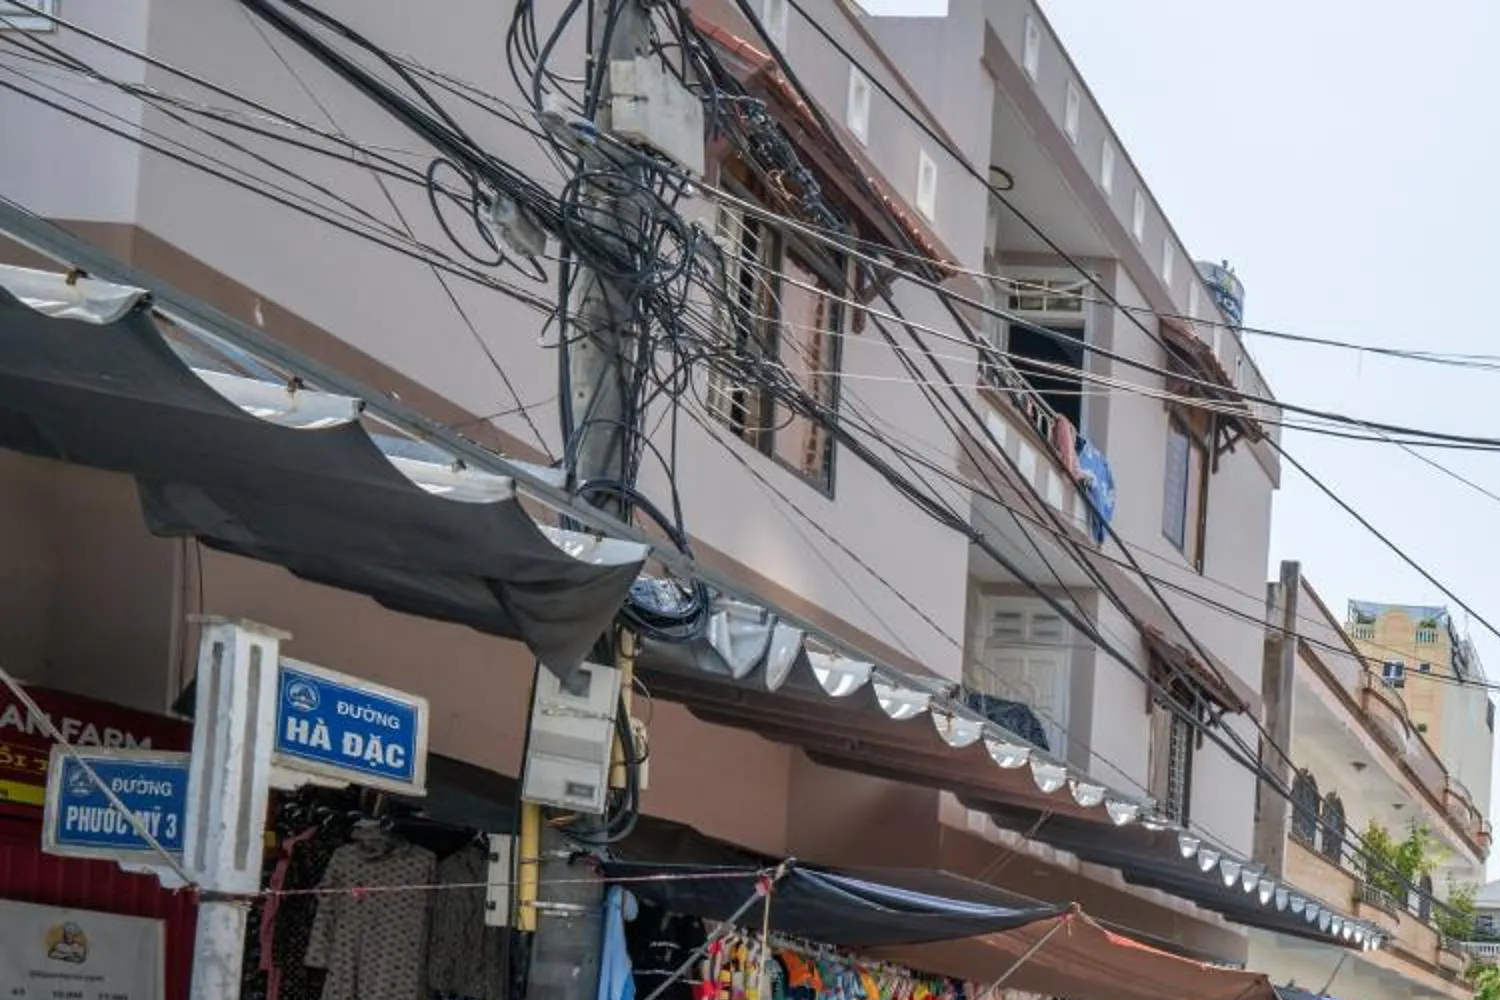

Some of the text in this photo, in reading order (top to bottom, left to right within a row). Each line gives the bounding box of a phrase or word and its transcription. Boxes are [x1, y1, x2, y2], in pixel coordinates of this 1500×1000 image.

[336, 701, 400, 729] ĐƯỜNG
[285, 716, 405, 768] HÀ ĐẶC
[165, 813, 177, 839] 3
